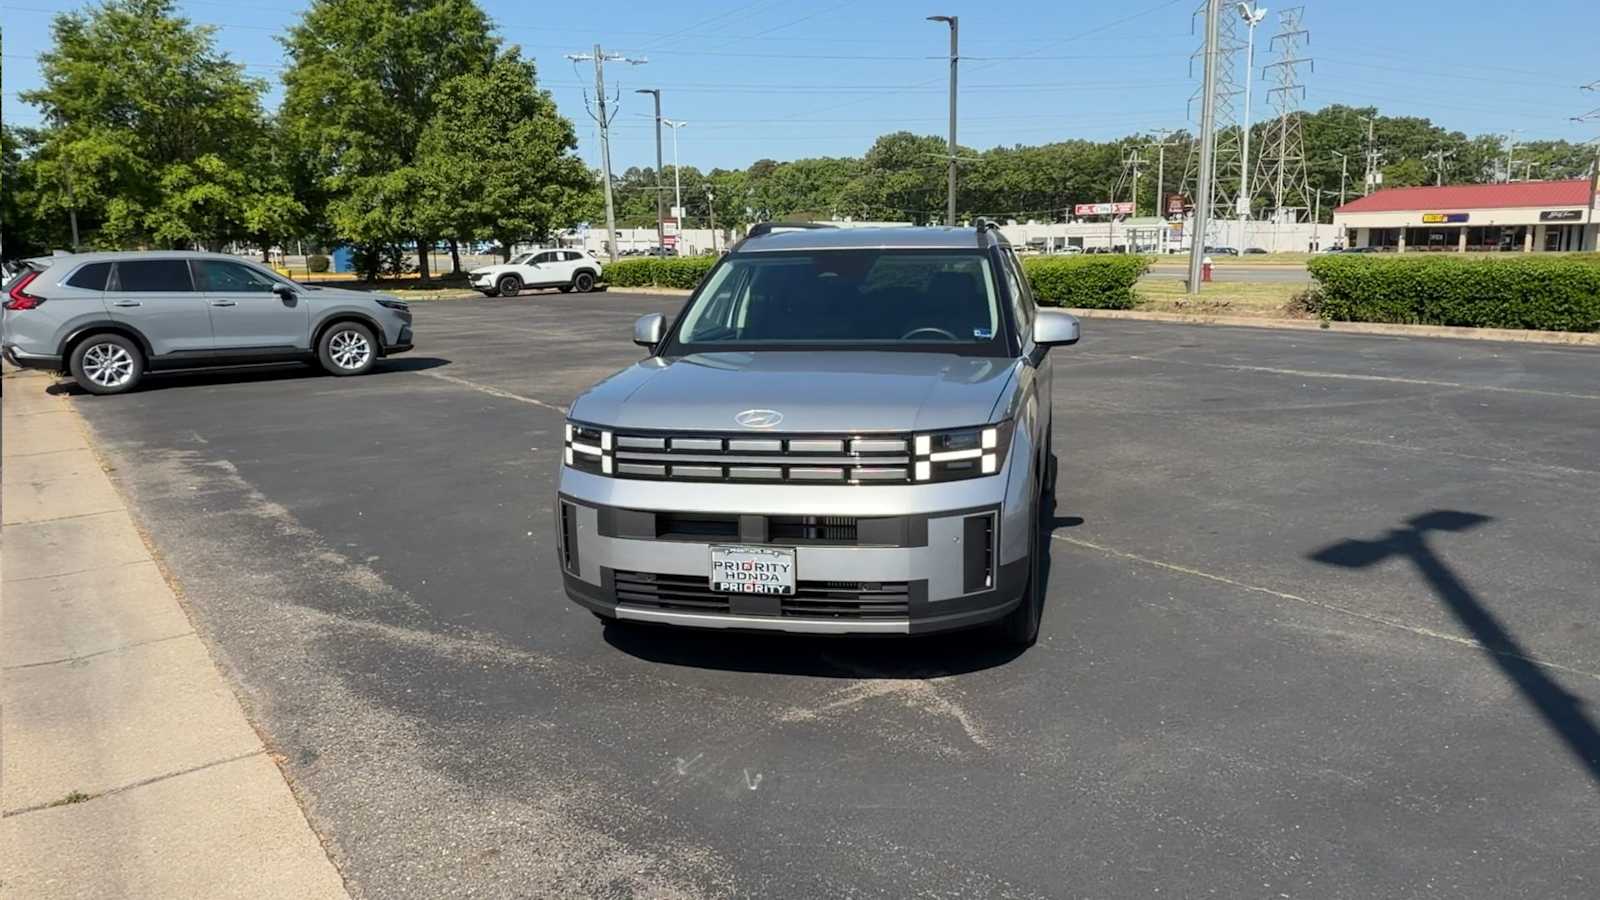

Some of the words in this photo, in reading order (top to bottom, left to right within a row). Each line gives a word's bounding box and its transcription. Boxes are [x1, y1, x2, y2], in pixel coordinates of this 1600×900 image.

[714, 560, 790, 573] PRIORITY
[725, 572, 780, 582] HONDA
[721, 582, 785, 593] PRIORITY
